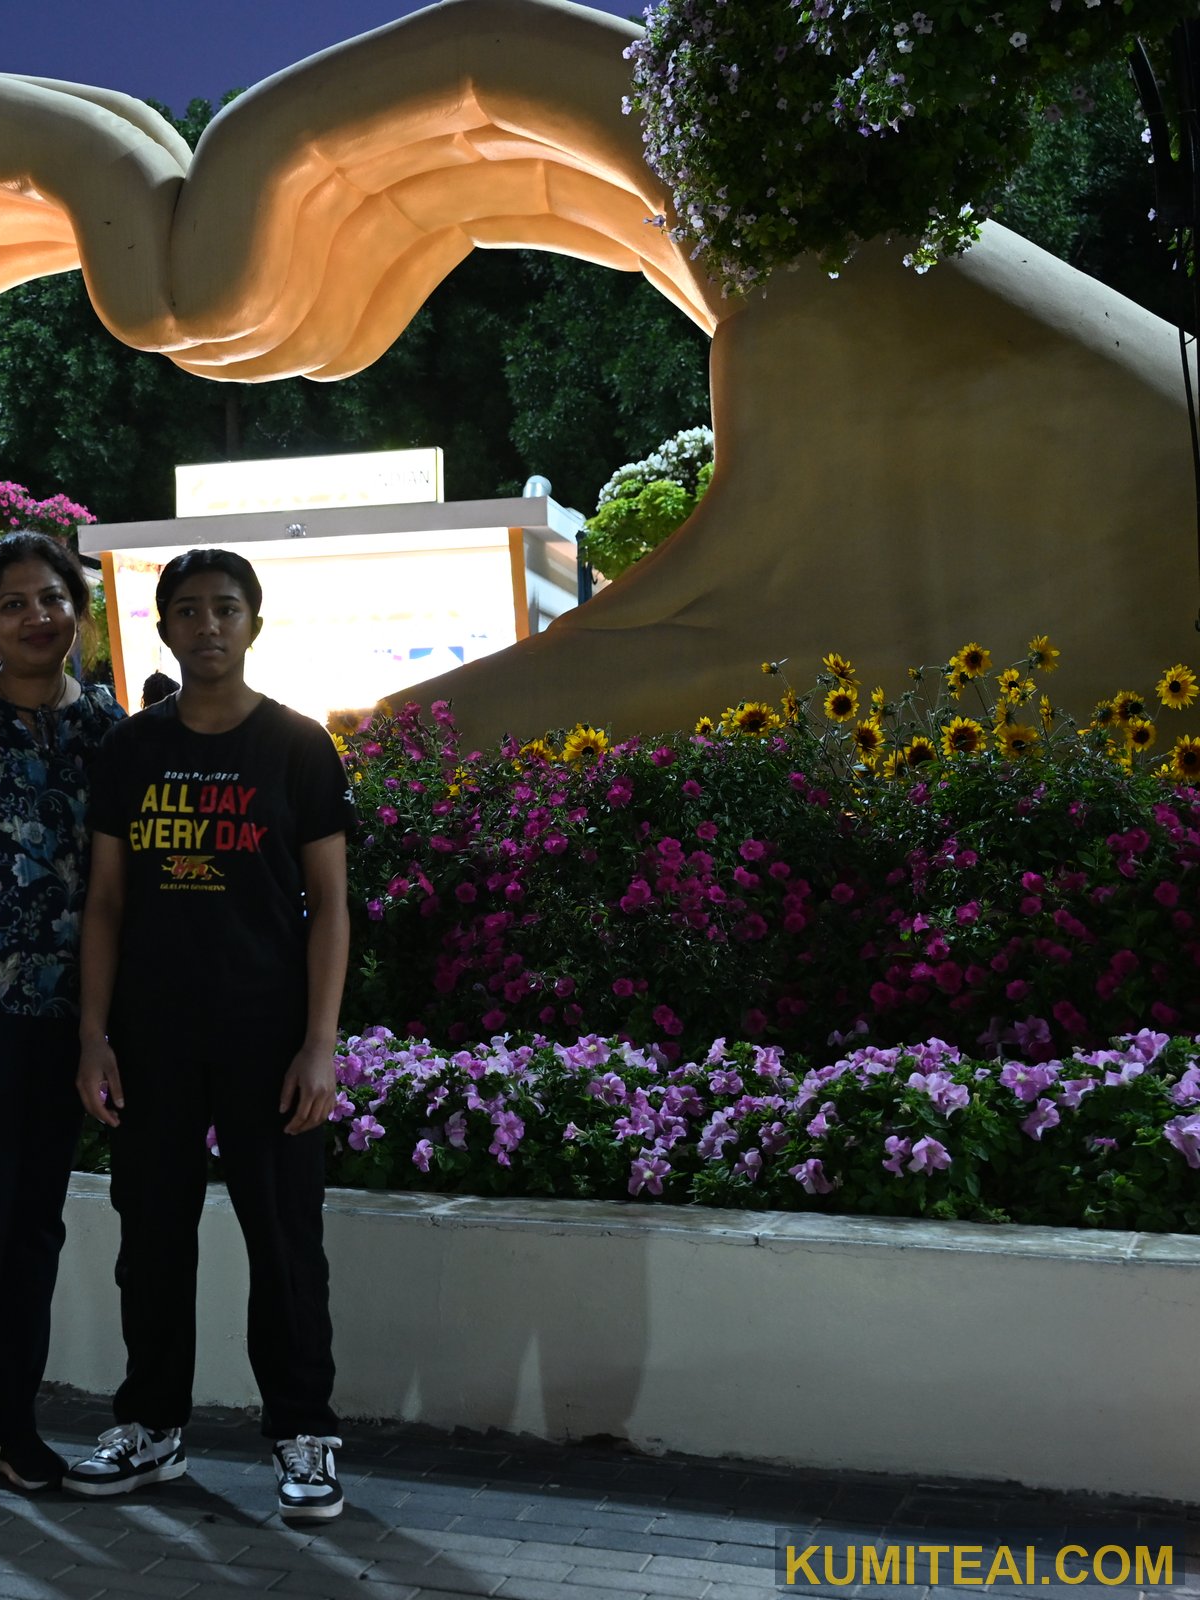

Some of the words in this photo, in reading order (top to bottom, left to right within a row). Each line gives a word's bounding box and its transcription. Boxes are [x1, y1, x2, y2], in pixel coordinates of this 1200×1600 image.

[163, 770, 190, 782] 2024
[140, 783, 193, 814] ALL
[199, 785, 257, 815] DAY
[128, 818, 210, 852] EVERY
[215, 820, 268, 853] DAY
